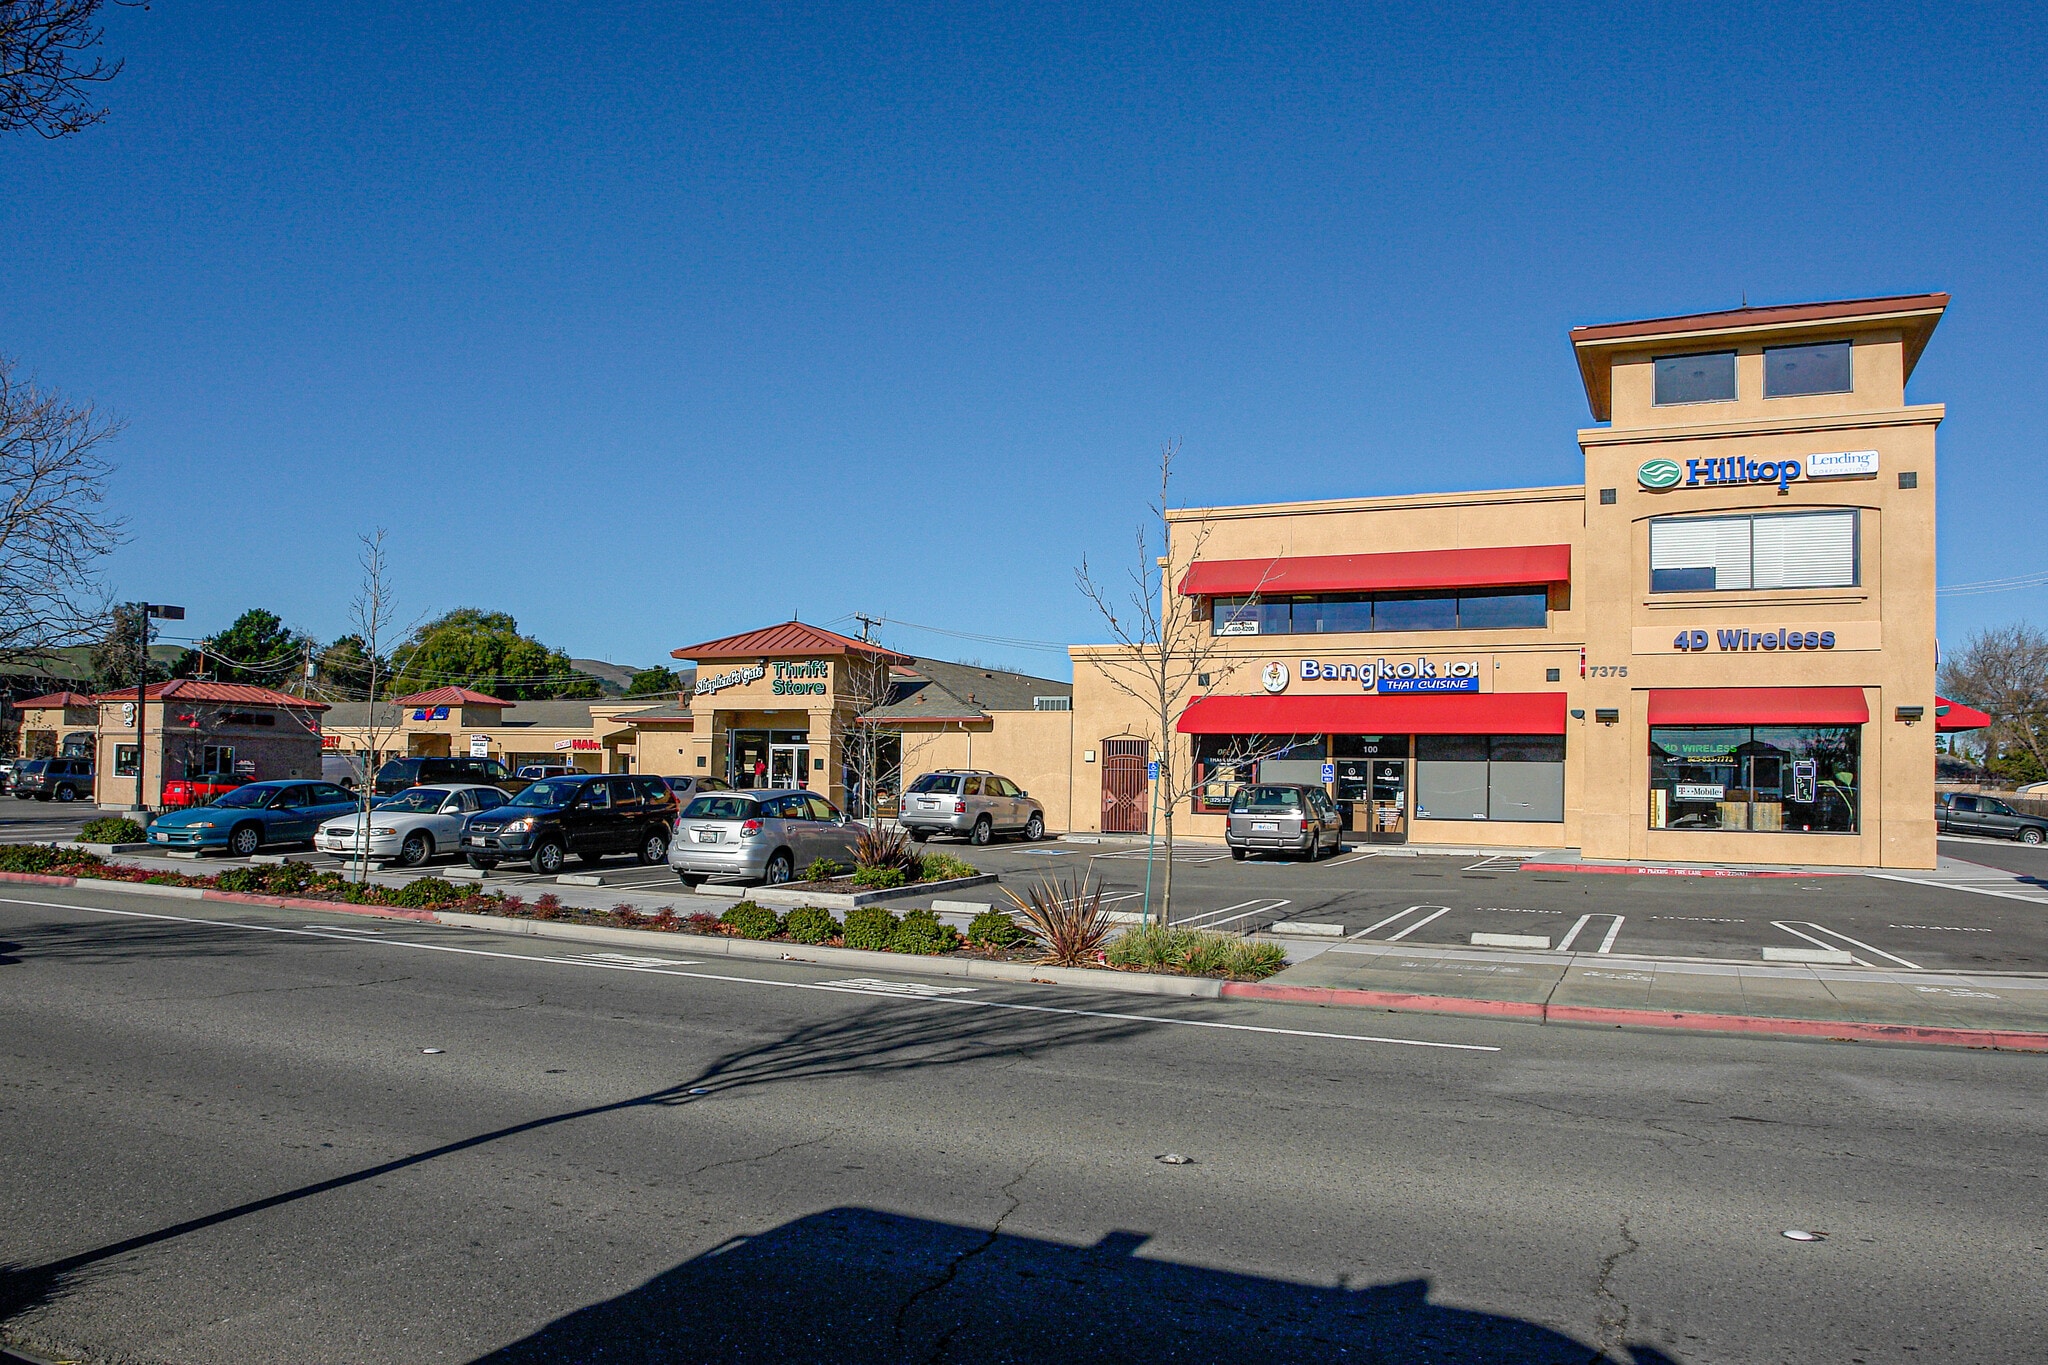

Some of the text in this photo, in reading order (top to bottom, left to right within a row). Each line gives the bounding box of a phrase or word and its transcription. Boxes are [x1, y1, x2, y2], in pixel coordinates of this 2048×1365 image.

[1811, 453, 1870, 468] Lending
[1686, 455, 1801, 490] Hilltop
[1673, 628, 1836, 651] 4D Wireless
[772, 660, 828, 678] Thrift
[1300, 658, 1479, 690] Bangkok 101
[1589, 666, 1628, 678] 7375
[695, 665, 765, 695] Shepherd's Gate
[772, 678, 826, 695] Store
[1386, 679, 1469, 691] THAI CUISINE
[1664, 744, 1738, 752] 4D WIRELESS
[1796, 777, 1812, 801] OPEN
